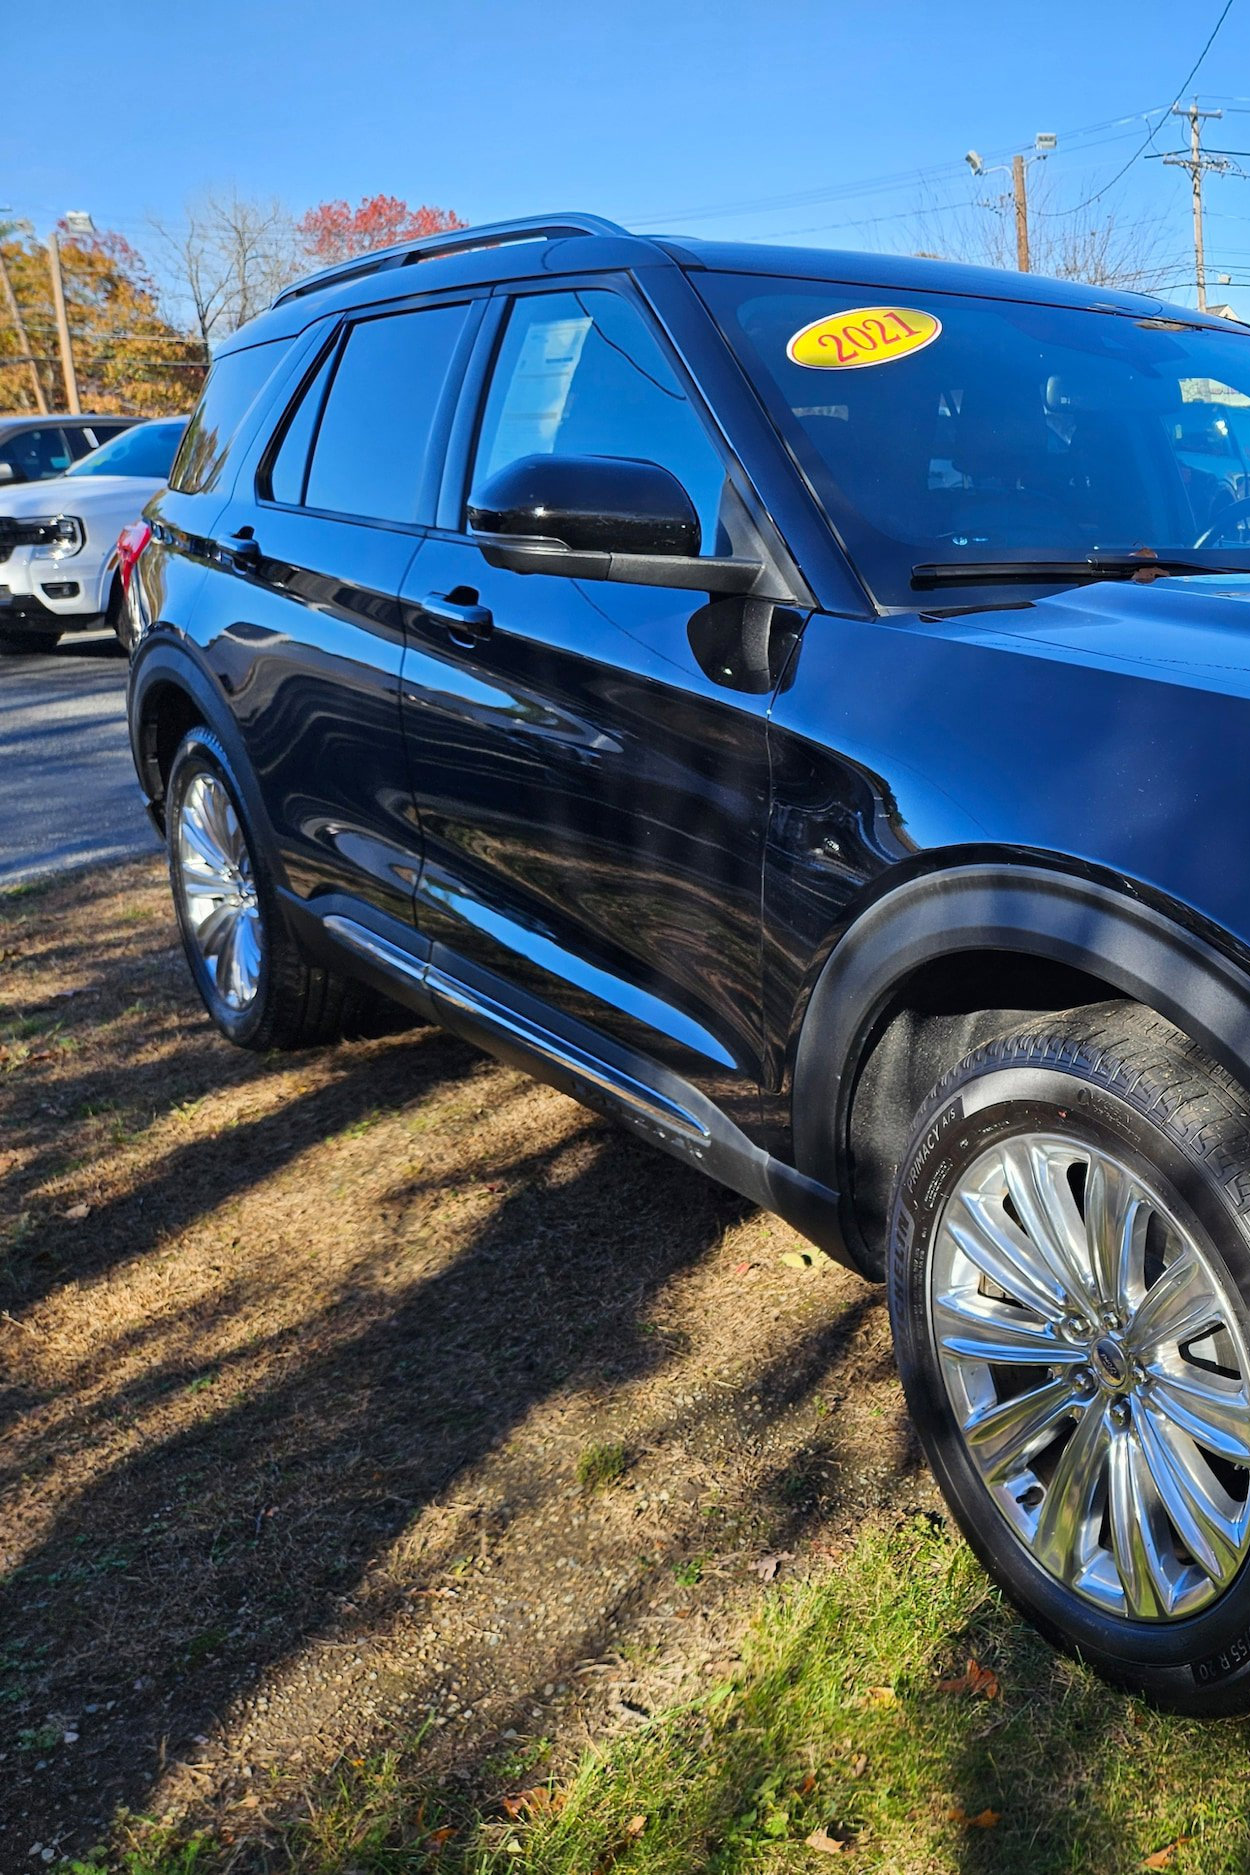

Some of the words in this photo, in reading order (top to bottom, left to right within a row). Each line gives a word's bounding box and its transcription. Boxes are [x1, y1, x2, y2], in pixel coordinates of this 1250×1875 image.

[818, 312, 922, 363] 2021
[906, 1123, 941, 1195] PRIMACY
[941, 1107, 957, 1129] A/S
